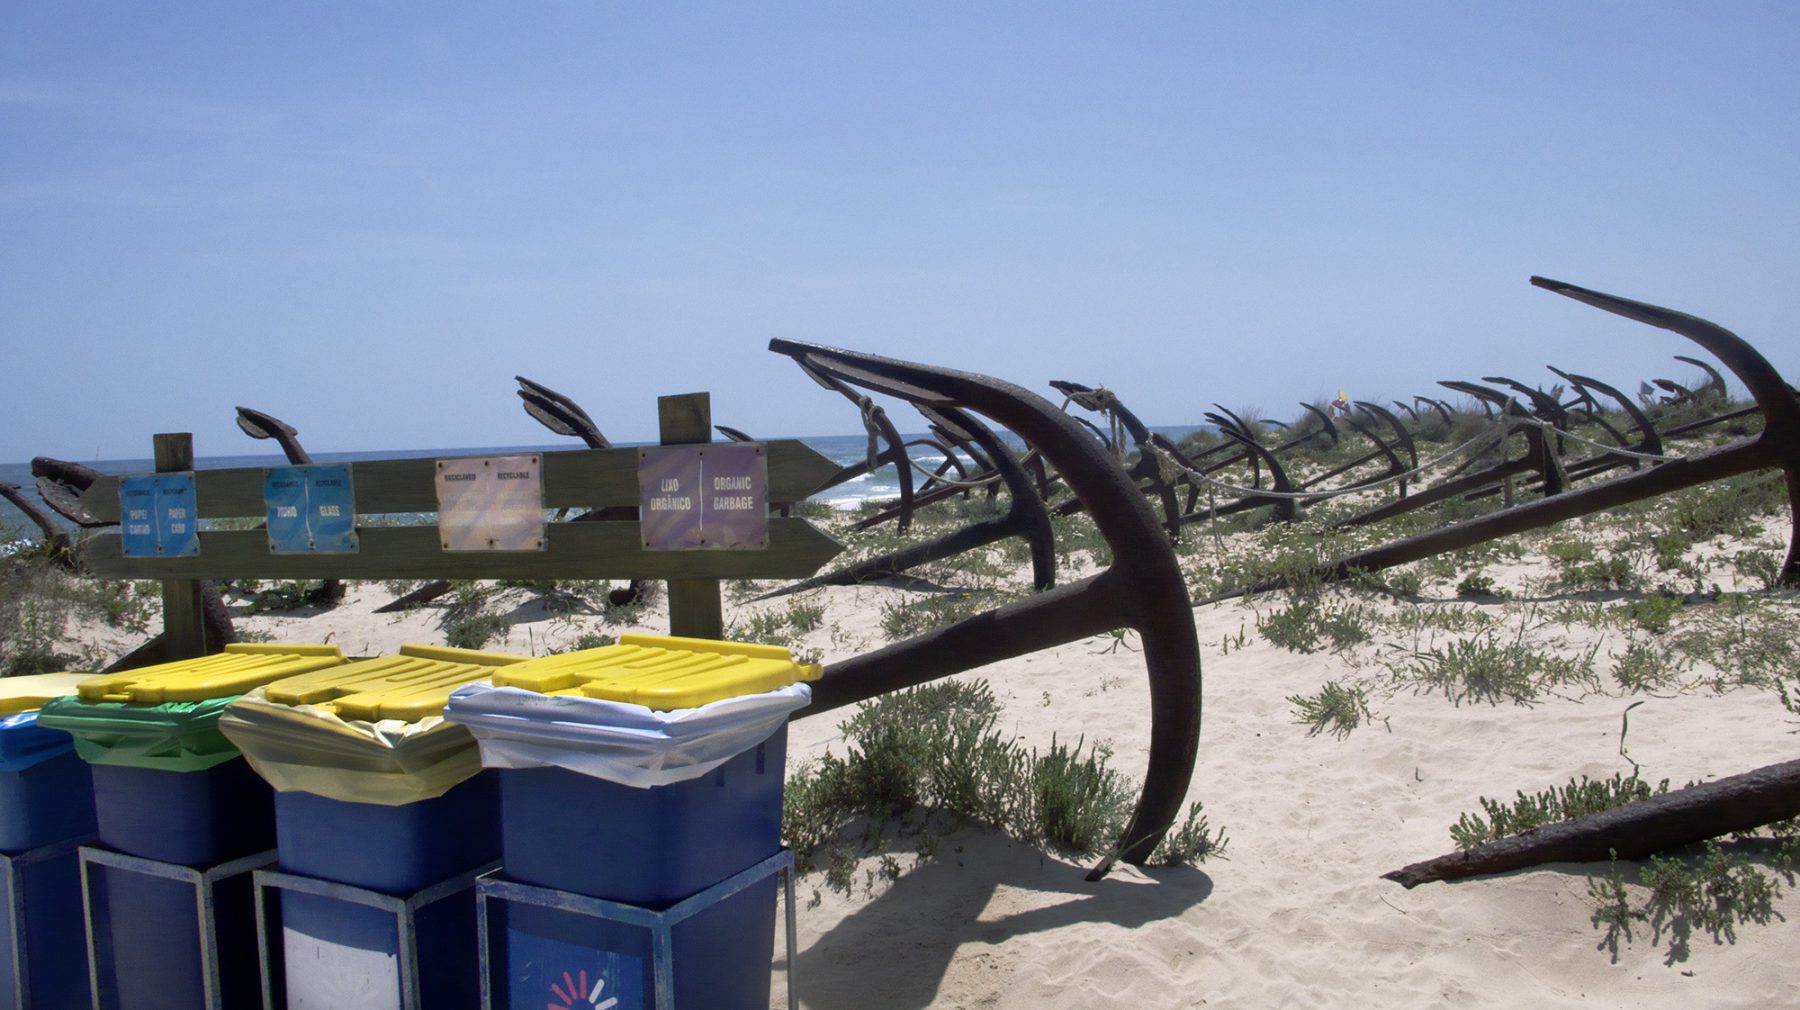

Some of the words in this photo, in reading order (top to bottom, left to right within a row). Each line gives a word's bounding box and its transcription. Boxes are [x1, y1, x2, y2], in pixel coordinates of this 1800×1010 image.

[661, 478, 680, 492] LIXO
[714, 476, 752, 490] ORGANIC
[650, 494, 691, 511] ORGÂNICO
[713, 496, 753, 510] GARBAGE
[319, 505, 341, 518] GLASS
